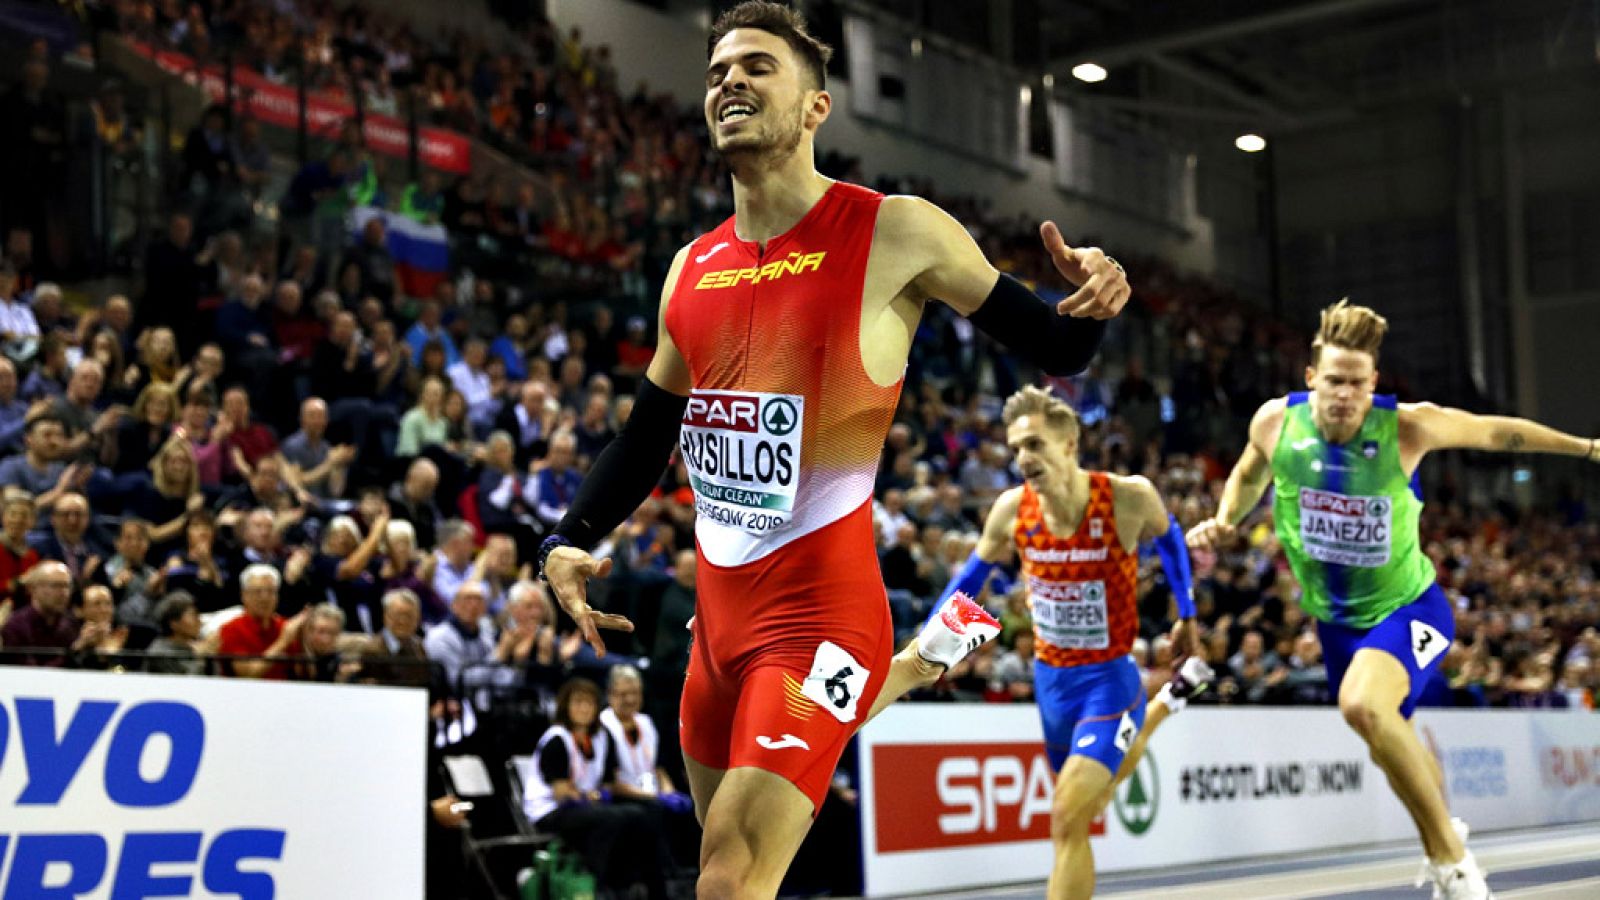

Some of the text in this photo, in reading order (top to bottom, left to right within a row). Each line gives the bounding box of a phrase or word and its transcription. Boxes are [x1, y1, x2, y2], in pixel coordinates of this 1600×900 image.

[694, 251, 827, 290] ESPAÑA
[682, 398, 756, 427] PAR
[724, 488, 762, 506] CLEAN
[747, 512, 784, 531] 2019
[1055, 604, 1104, 625] DIEPEN
[1417, 630, 1433, 652] 3
[825, 666, 854, 709] 6
[0, 696, 206, 809] YO
[936, 755, 1102, 834] SPA
[0, 828, 286, 900] RES
